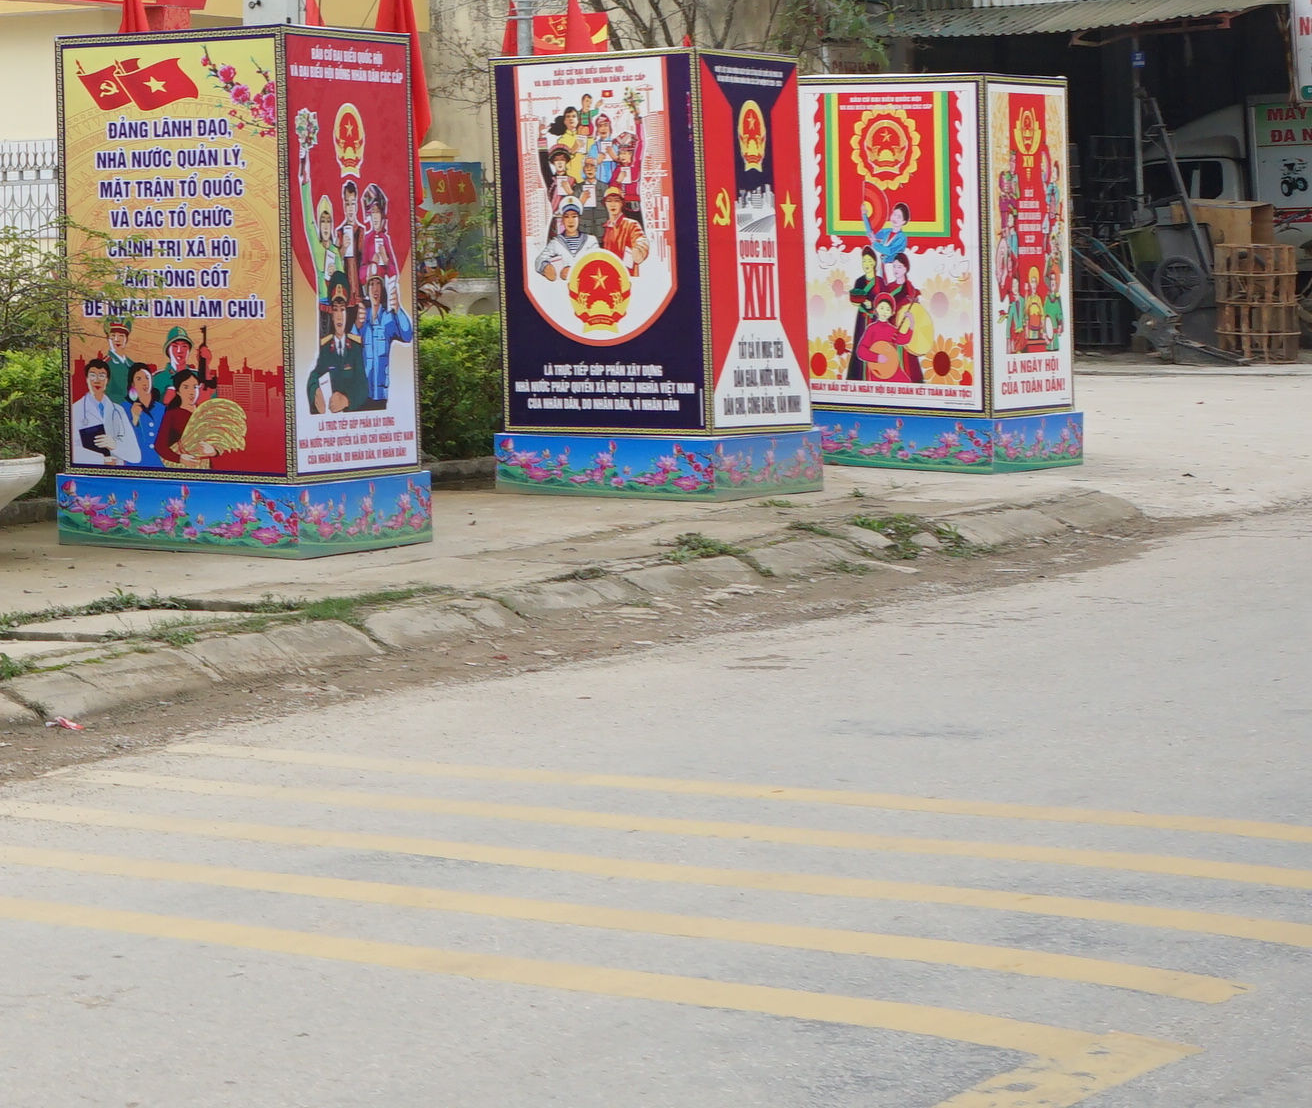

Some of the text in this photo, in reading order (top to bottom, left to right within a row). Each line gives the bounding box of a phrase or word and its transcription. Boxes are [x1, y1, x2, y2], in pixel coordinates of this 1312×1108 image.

[108, 116, 232, 140] ĐẢNG LÃNH ĐẠO,
[1271, 130, 1295, 142] ĐA
[97, 144, 245, 168] NHÀ NƯỚC QUẢN LÝ,
[100, 173, 243, 202] MẶT TRẬN TỔ QUỐC
[110, 204, 232, 228] VÀ CÁC TỔ CHỨC
[158, 240, 181, 261] TRỊ
[186, 237, 206, 257] XÃ
[211, 236, 236, 261] HỘI
[740, 234, 774, 261] QUỐC HỘI
[201, 264, 229, 287] CỐT
[741, 263, 777, 320] XVI
[190, 296, 222, 317] LÀM
[228, 294, 264, 318] CHỦ!
[1007, 356, 1059, 374] LÀ NGÀY HỘI
[1002, 376, 1065, 395] CỦA TOÀN DÂN!
